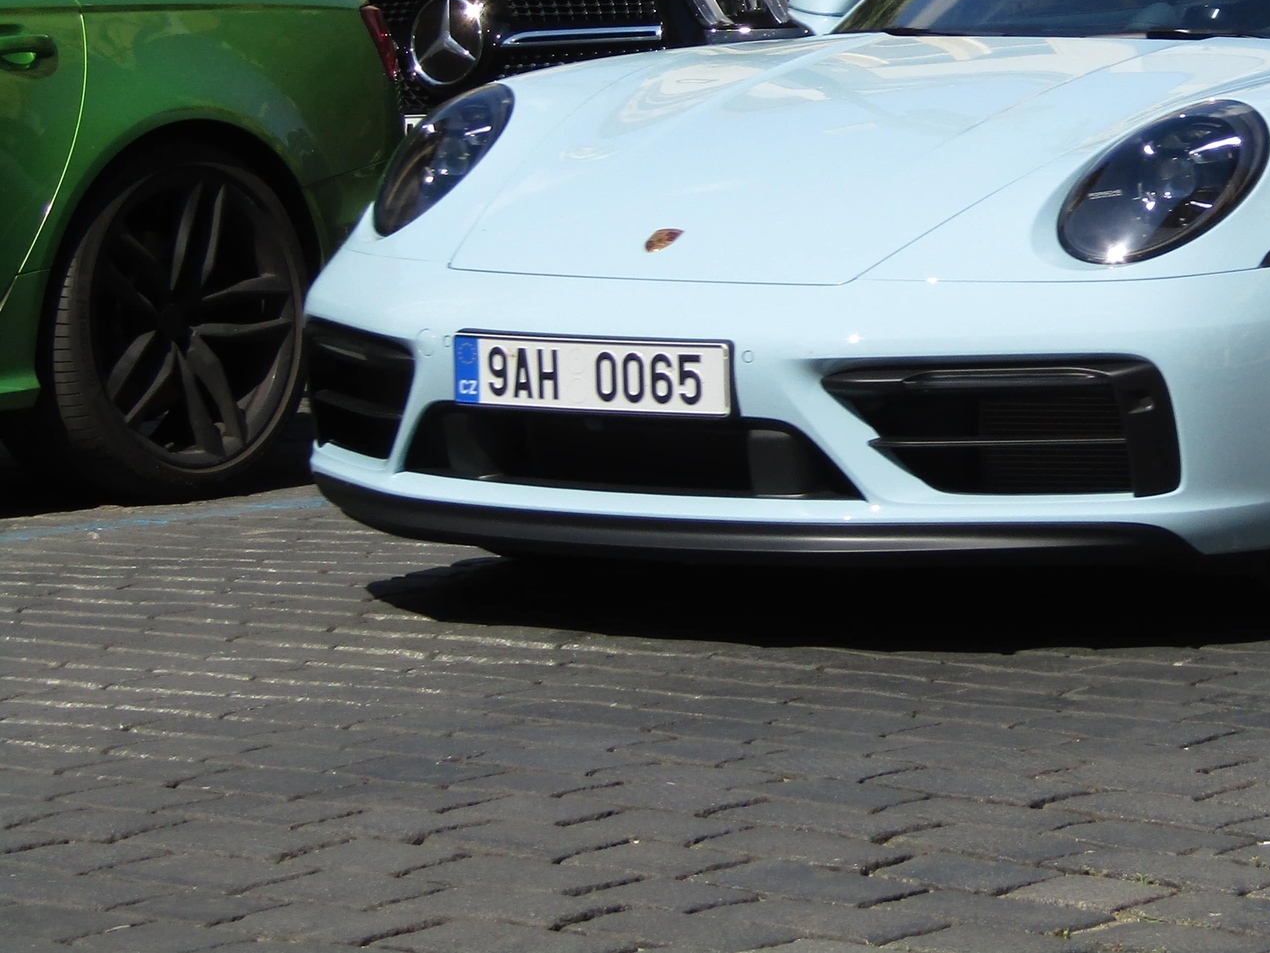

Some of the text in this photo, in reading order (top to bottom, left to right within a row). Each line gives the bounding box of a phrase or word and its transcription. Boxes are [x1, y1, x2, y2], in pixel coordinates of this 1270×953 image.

[459, 380, 478, 395] CZ
[488, 346, 703, 405] 9AH 0065
